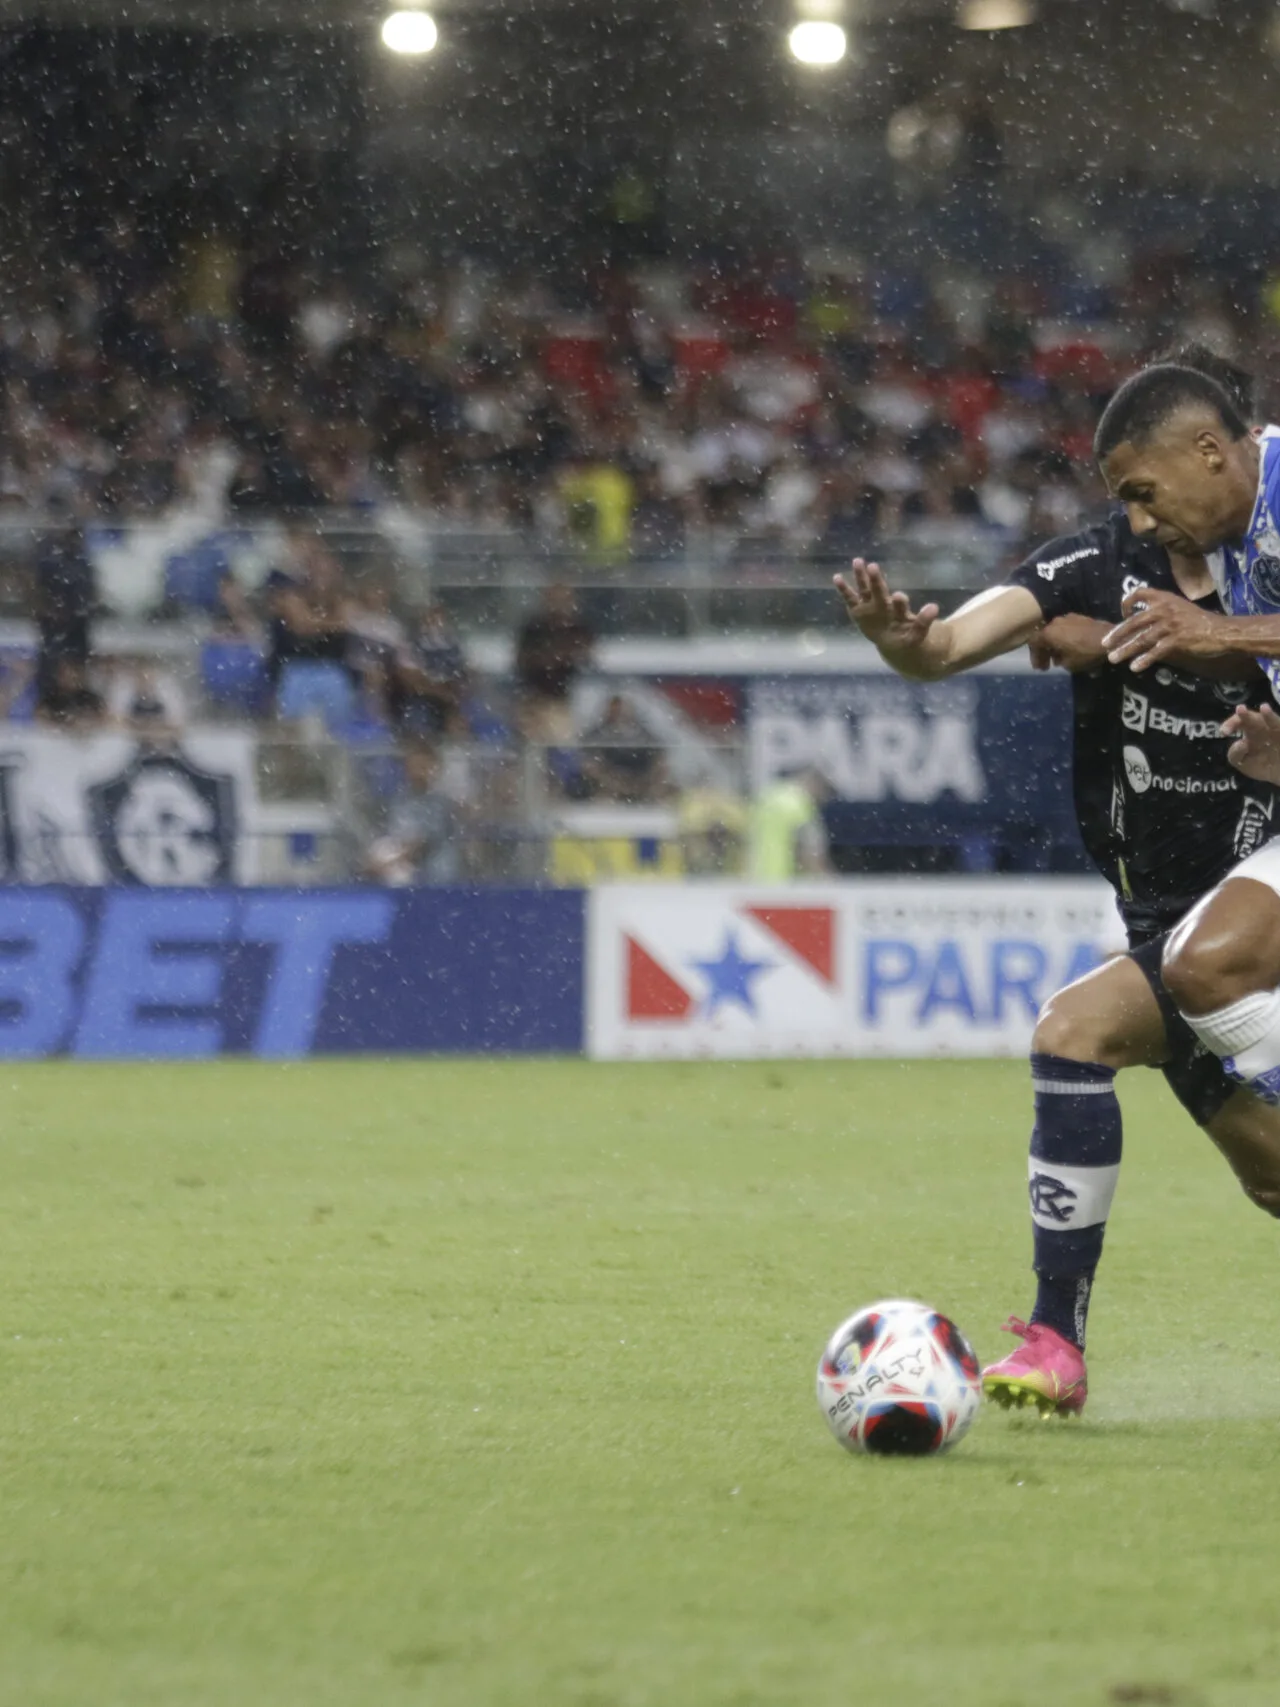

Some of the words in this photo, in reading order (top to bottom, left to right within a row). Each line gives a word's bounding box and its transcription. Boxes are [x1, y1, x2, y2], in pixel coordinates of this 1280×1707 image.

[1148, 706, 1244, 741] Banpa
[0, 892, 394, 1058] BET
[828, 1347, 922, 1421] PENALTY
